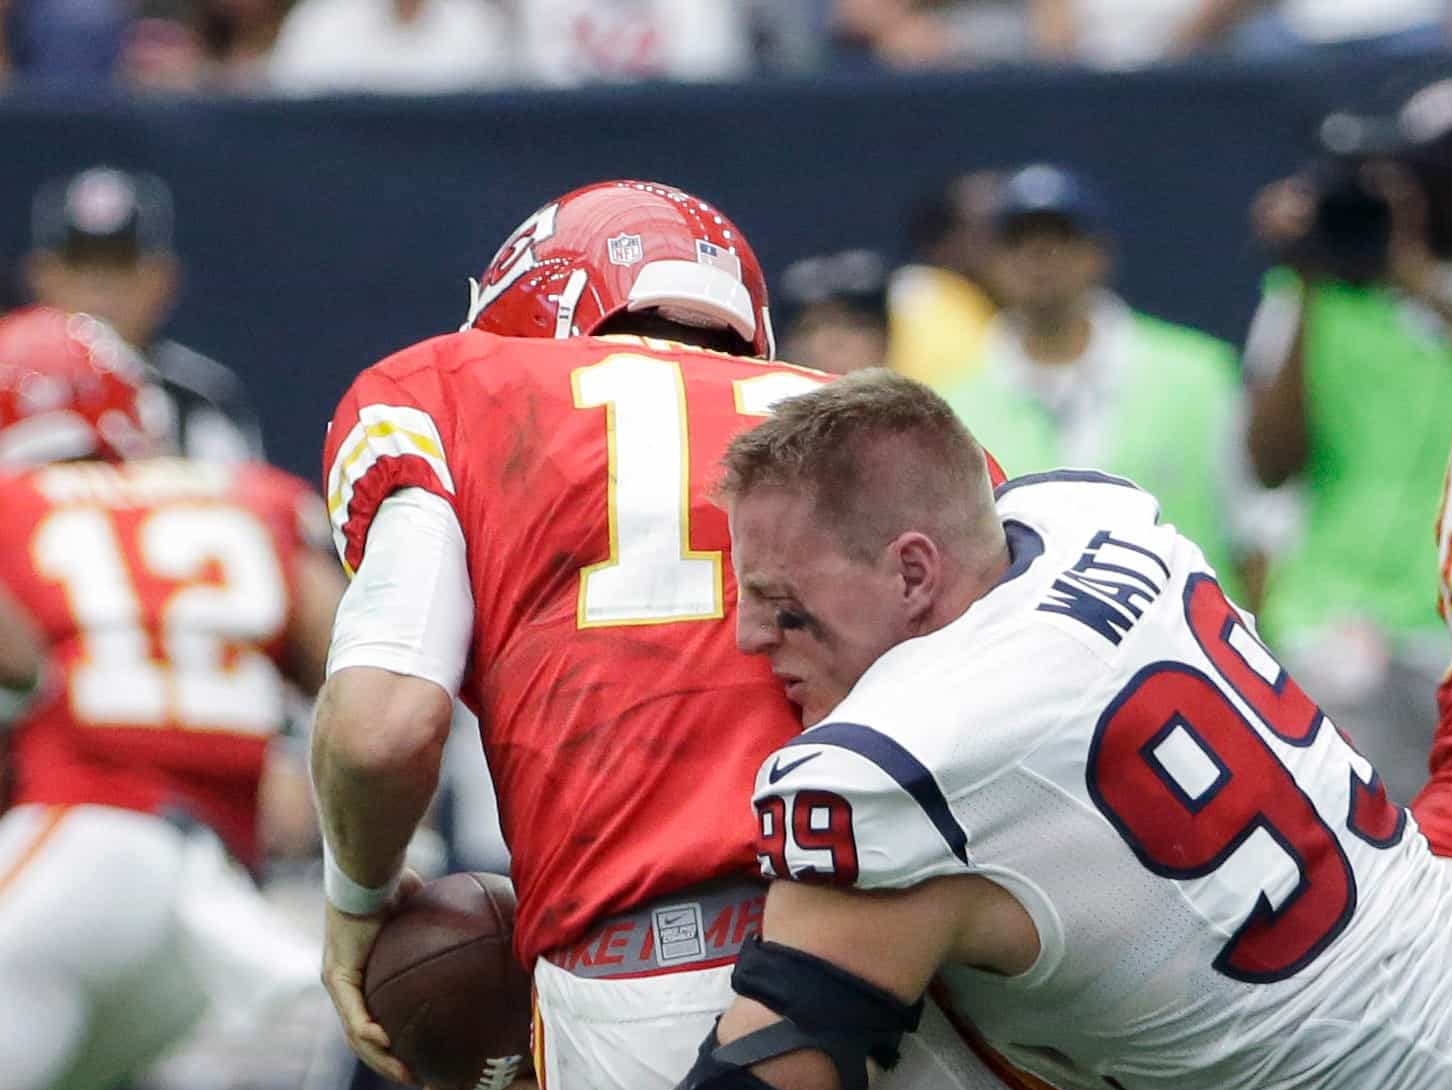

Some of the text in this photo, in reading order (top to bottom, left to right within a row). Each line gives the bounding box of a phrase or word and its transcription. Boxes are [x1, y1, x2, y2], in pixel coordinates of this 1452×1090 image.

[30, 500, 288, 738] 12
[1035, 530, 1171, 648] WATT
[753, 789, 860, 884] 99
[1085, 571, 1406, 985] 99
